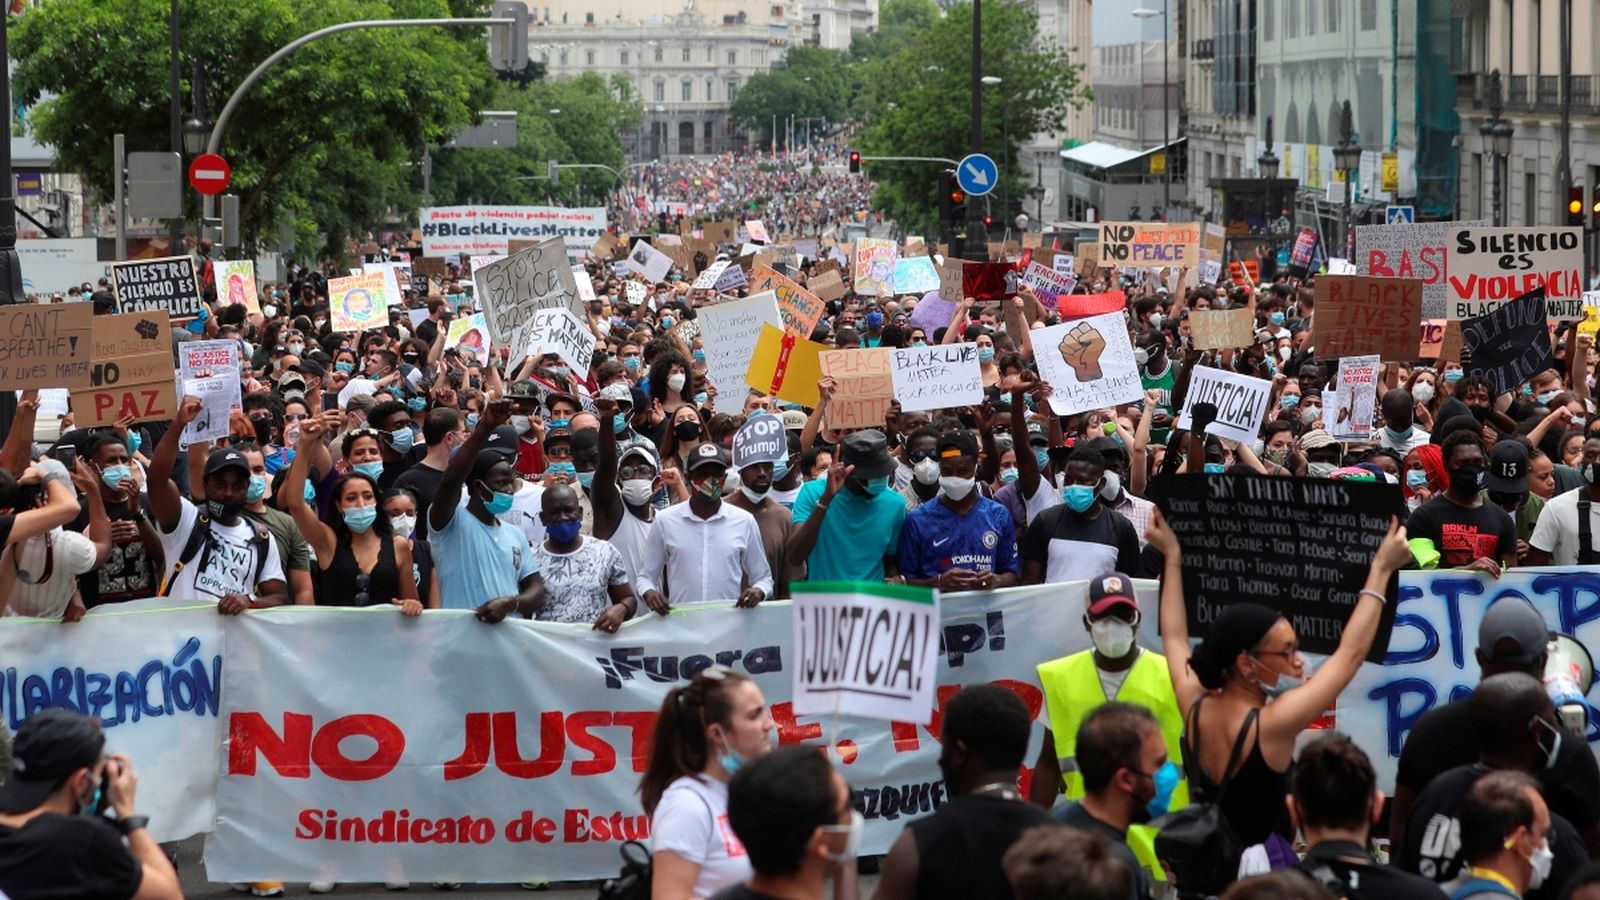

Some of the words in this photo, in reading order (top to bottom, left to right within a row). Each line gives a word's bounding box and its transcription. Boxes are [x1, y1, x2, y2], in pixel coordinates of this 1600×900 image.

[465, 210, 476, 218] de
[481, 211, 523, 219] violencia
[527, 212, 559, 220] policial
[422, 222, 605, 238] #BlackLivesMatter
[1103, 226, 1135, 243] NO
[1103, 244, 1129, 261] NO
[1133, 244, 1185, 261] PEACE
[1456, 231, 1579, 255] SILENCIO
[116, 261, 190, 284] NUESTRO
[487, 248, 543, 287] STOP
[1034, 265, 1068, 286] RACISM
[120, 281, 174, 302] SILENCIO
[179, 278, 194, 293] ES
[492, 267, 560, 310] POLICE
[761, 277, 771, 290] A
[1035, 277, 1050, 291] THE
[1329, 280, 1416, 307] BLACK
[1449, 270, 1583, 300] VIOLENCIA
[775, 284, 820, 319] CHANGE
[1457, 301, 1503, 319] BLAC
[705, 312, 728, 333] No
[1335, 304, 1411, 328] LIVES
[1463, 297, 1547, 353] DEFUND
[561, 313, 593, 358] TRANS
[188, 352, 200, 360] NO
[547, 328, 590, 371] MATTER
[895, 350, 943, 370] BLACK
[16, 364, 47, 380] LIVES
[91, 362, 120, 387] NO
[128, 366, 153, 379] HAY
[907, 366, 953, 383] MATTER
[94, 390, 166, 422] PAZ
[830, 397, 893, 426] MATTE
[1072, 391, 1134, 409] MATTER
[736, 420, 780, 448] STOP
[740, 438, 779, 460] Trump!
[1502, 463, 1517, 477] 13
[1208, 476, 1236, 499] SAY
[1247, 478, 1295, 502] THEIR
[1303, 485, 1350, 507] NAMES
[1206, 500, 1230, 514] Rice
[1318, 510, 1356, 527] Sandra
[1335, 527, 1357, 543] Eric
[1442, 524, 1477, 534] BRKLN
[951, 554, 993, 566] YOKOHAMA
[1224, 534, 1263, 552] Castile
[1343, 546, 1367, 565] Sean
[206, 555, 239, 583] AYS
[1207, 554, 1246, 572] Martin
[1198, 573, 1230, 592] Tiara
[1237, 576, 1280, 596] Thomas
[1291, 583, 1323, 601] Oscar
[801, 605, 930, 692] ¡JUSTICIA!
[597, 645, 783, 690] ¡Fuera
[229, 711, 406, 782] NO
[295, 809, 495, 844] Sindicato
[505, 810, 557, 844] de
